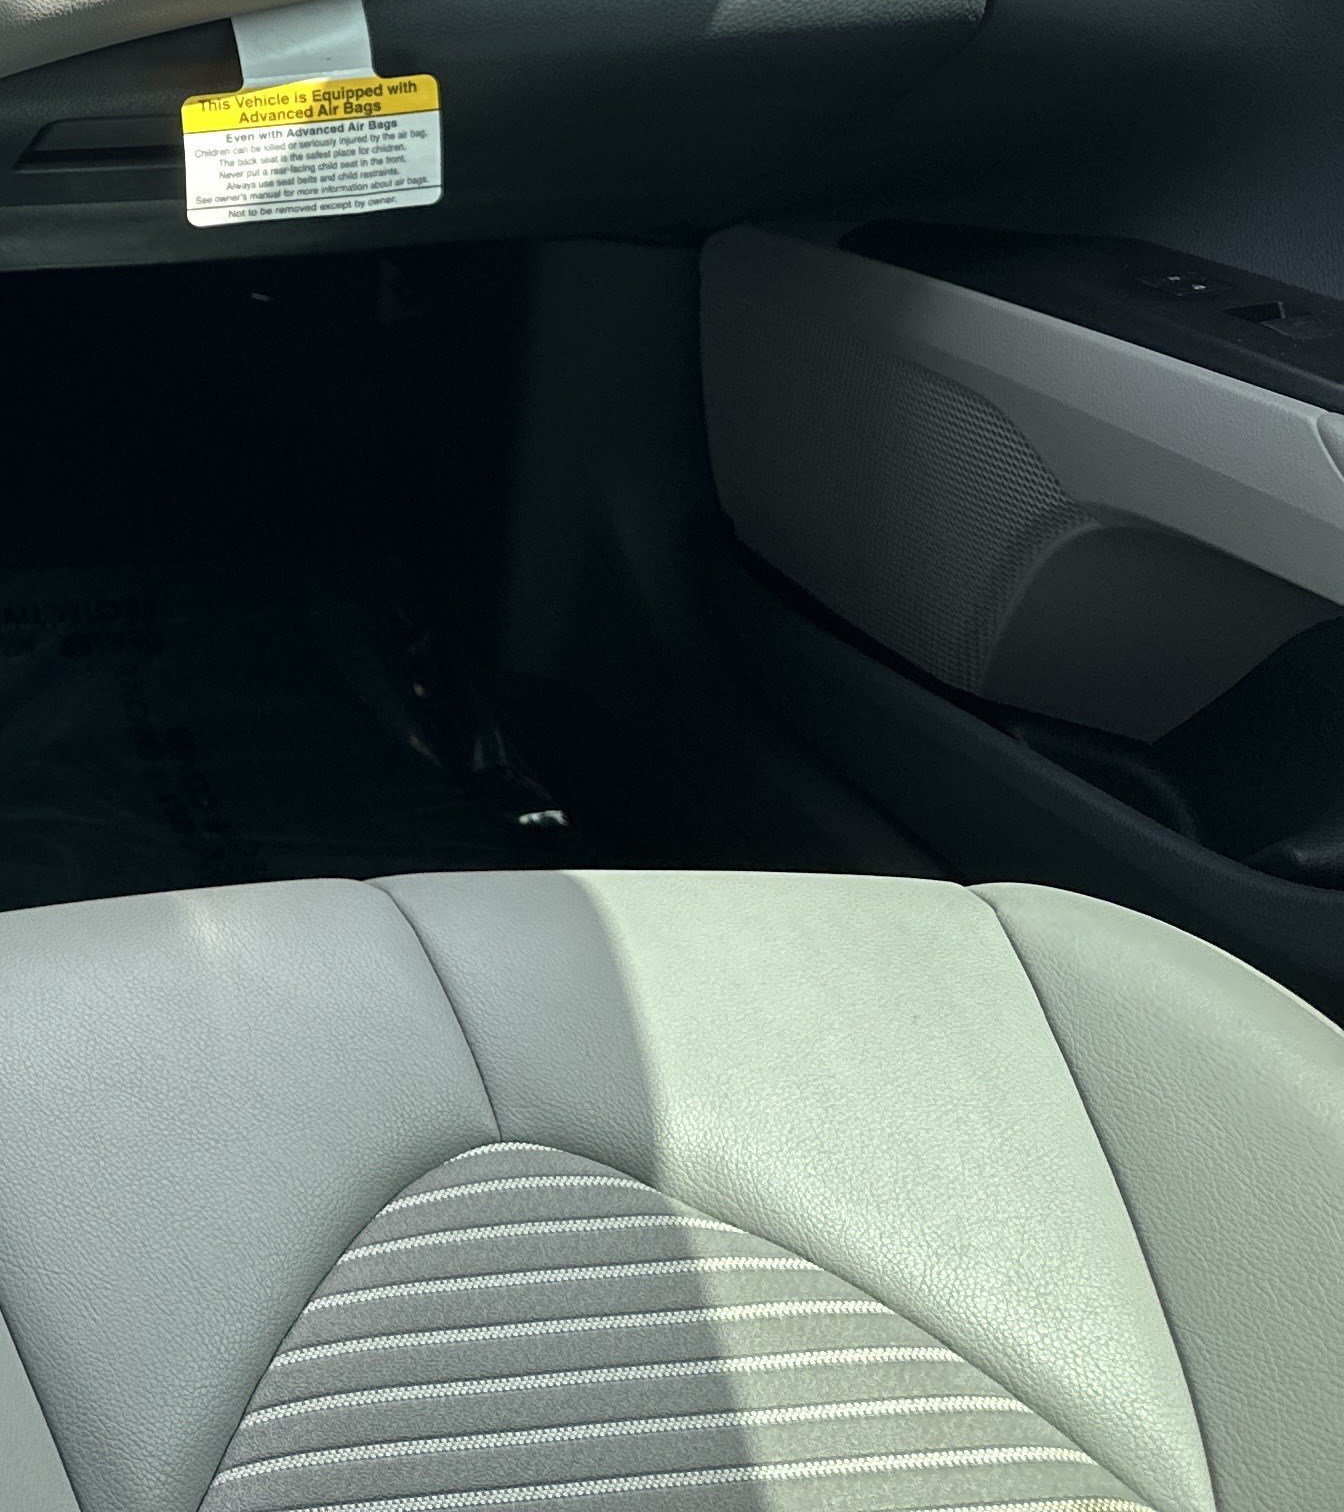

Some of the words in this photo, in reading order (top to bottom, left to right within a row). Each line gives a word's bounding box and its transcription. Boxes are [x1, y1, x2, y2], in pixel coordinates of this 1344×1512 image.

[198, 97, 231, 112] This
[234, 92, 290, 108] Vehicle
[294, 91, 308, 103] is
[311, 83, 384, 104] Equipped
[386, 80, 418, 95] with
[238, 104, 314, 124] Advanced
[317, 103, 339, 117] Air
[343, 101, 382, 115] Bags
[225, 133, 255, 143] Even
[258, 129, 283, 140] with
[286, 123, 345, 138] Advanced
[348, 121, 364, 132] Air
[368, 119, 398, 131] Bags
